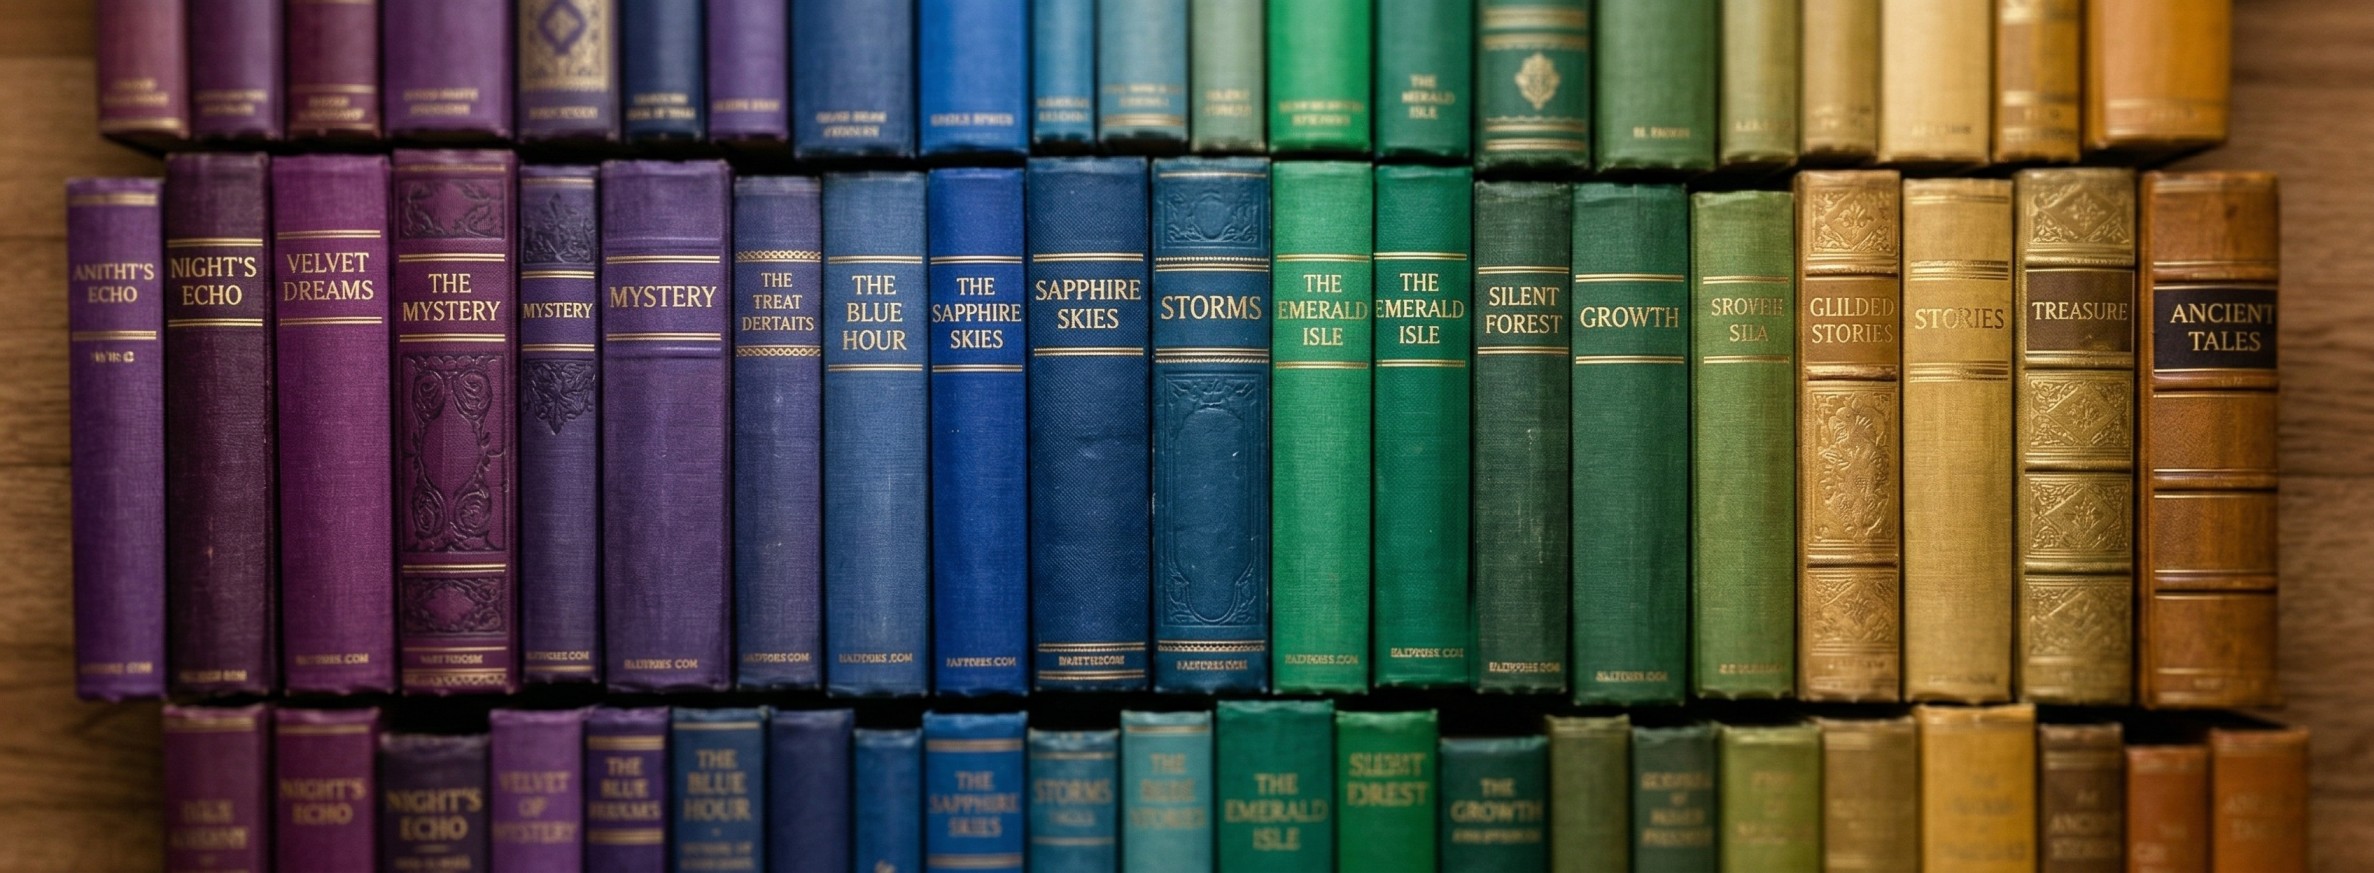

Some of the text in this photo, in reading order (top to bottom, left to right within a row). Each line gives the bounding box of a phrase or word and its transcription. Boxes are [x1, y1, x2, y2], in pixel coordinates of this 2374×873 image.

[170, 257, 257, 279] NIGHT'S
[286, 252, 370, 274] VELVET
[284, 280, 374, 301] DREAMS
[428, 273, 472, 294] THE
[761, 272, 793, 288] THE
[852, 275, 897, 296] THE
[956, 277, 996, 297] THE
[1035, 279, 1142, 302] SAPPHIRE
[1303, 274, 1343, 294] THE
[1399, 273, 1440, 293] THE
[87, 286, 138, 303] ECHO
[182, 285, 242, 306] ECHO
[609, 285, 717, 308] MYSTERY
[1488, 286, 1560, 307] SILENT
[403, 300, 501, 322] MYSTERY
[523, 302, 593, 319] MYSTERY
[846, 302, 903, 323] BLUE
[932, 303, 1022, 323] SAPPHIRE
[1160, 294, 1262, 321] STORMS
[1277, 300, 1368, 321] EMERALD
[1375, 298, 1465, 319] EMERALD
[1580, 306, 1680, 330] GROWTH
[2032, 301, 2129, 321] TREASURE
[2170, 302, 2277, 324] ANCIENT
[1057, 308, 1119, 330] SKIES
[1485, 314, 1563, 335] FOREST
[1914, 307, 2005, 330] STORIES
[842, 329, 907, 351] HOUR
[950, 329, 1004, 350] SKIES
[1302, 326, 1344, 347] ISLE
[1399, 325, 1440, 345] ISLE
[1811, 324, 1894, 344] STORIES
[2188, 331, 2262, 352] TALES
[696, 749, 738, 769] THE
[686, 771, 747, 794] BLUE
[1254, 773, 1298, 795] THE
[386, 788, 483, 813] NIGHT'S
[399, 815, 470, 841] ECHO
